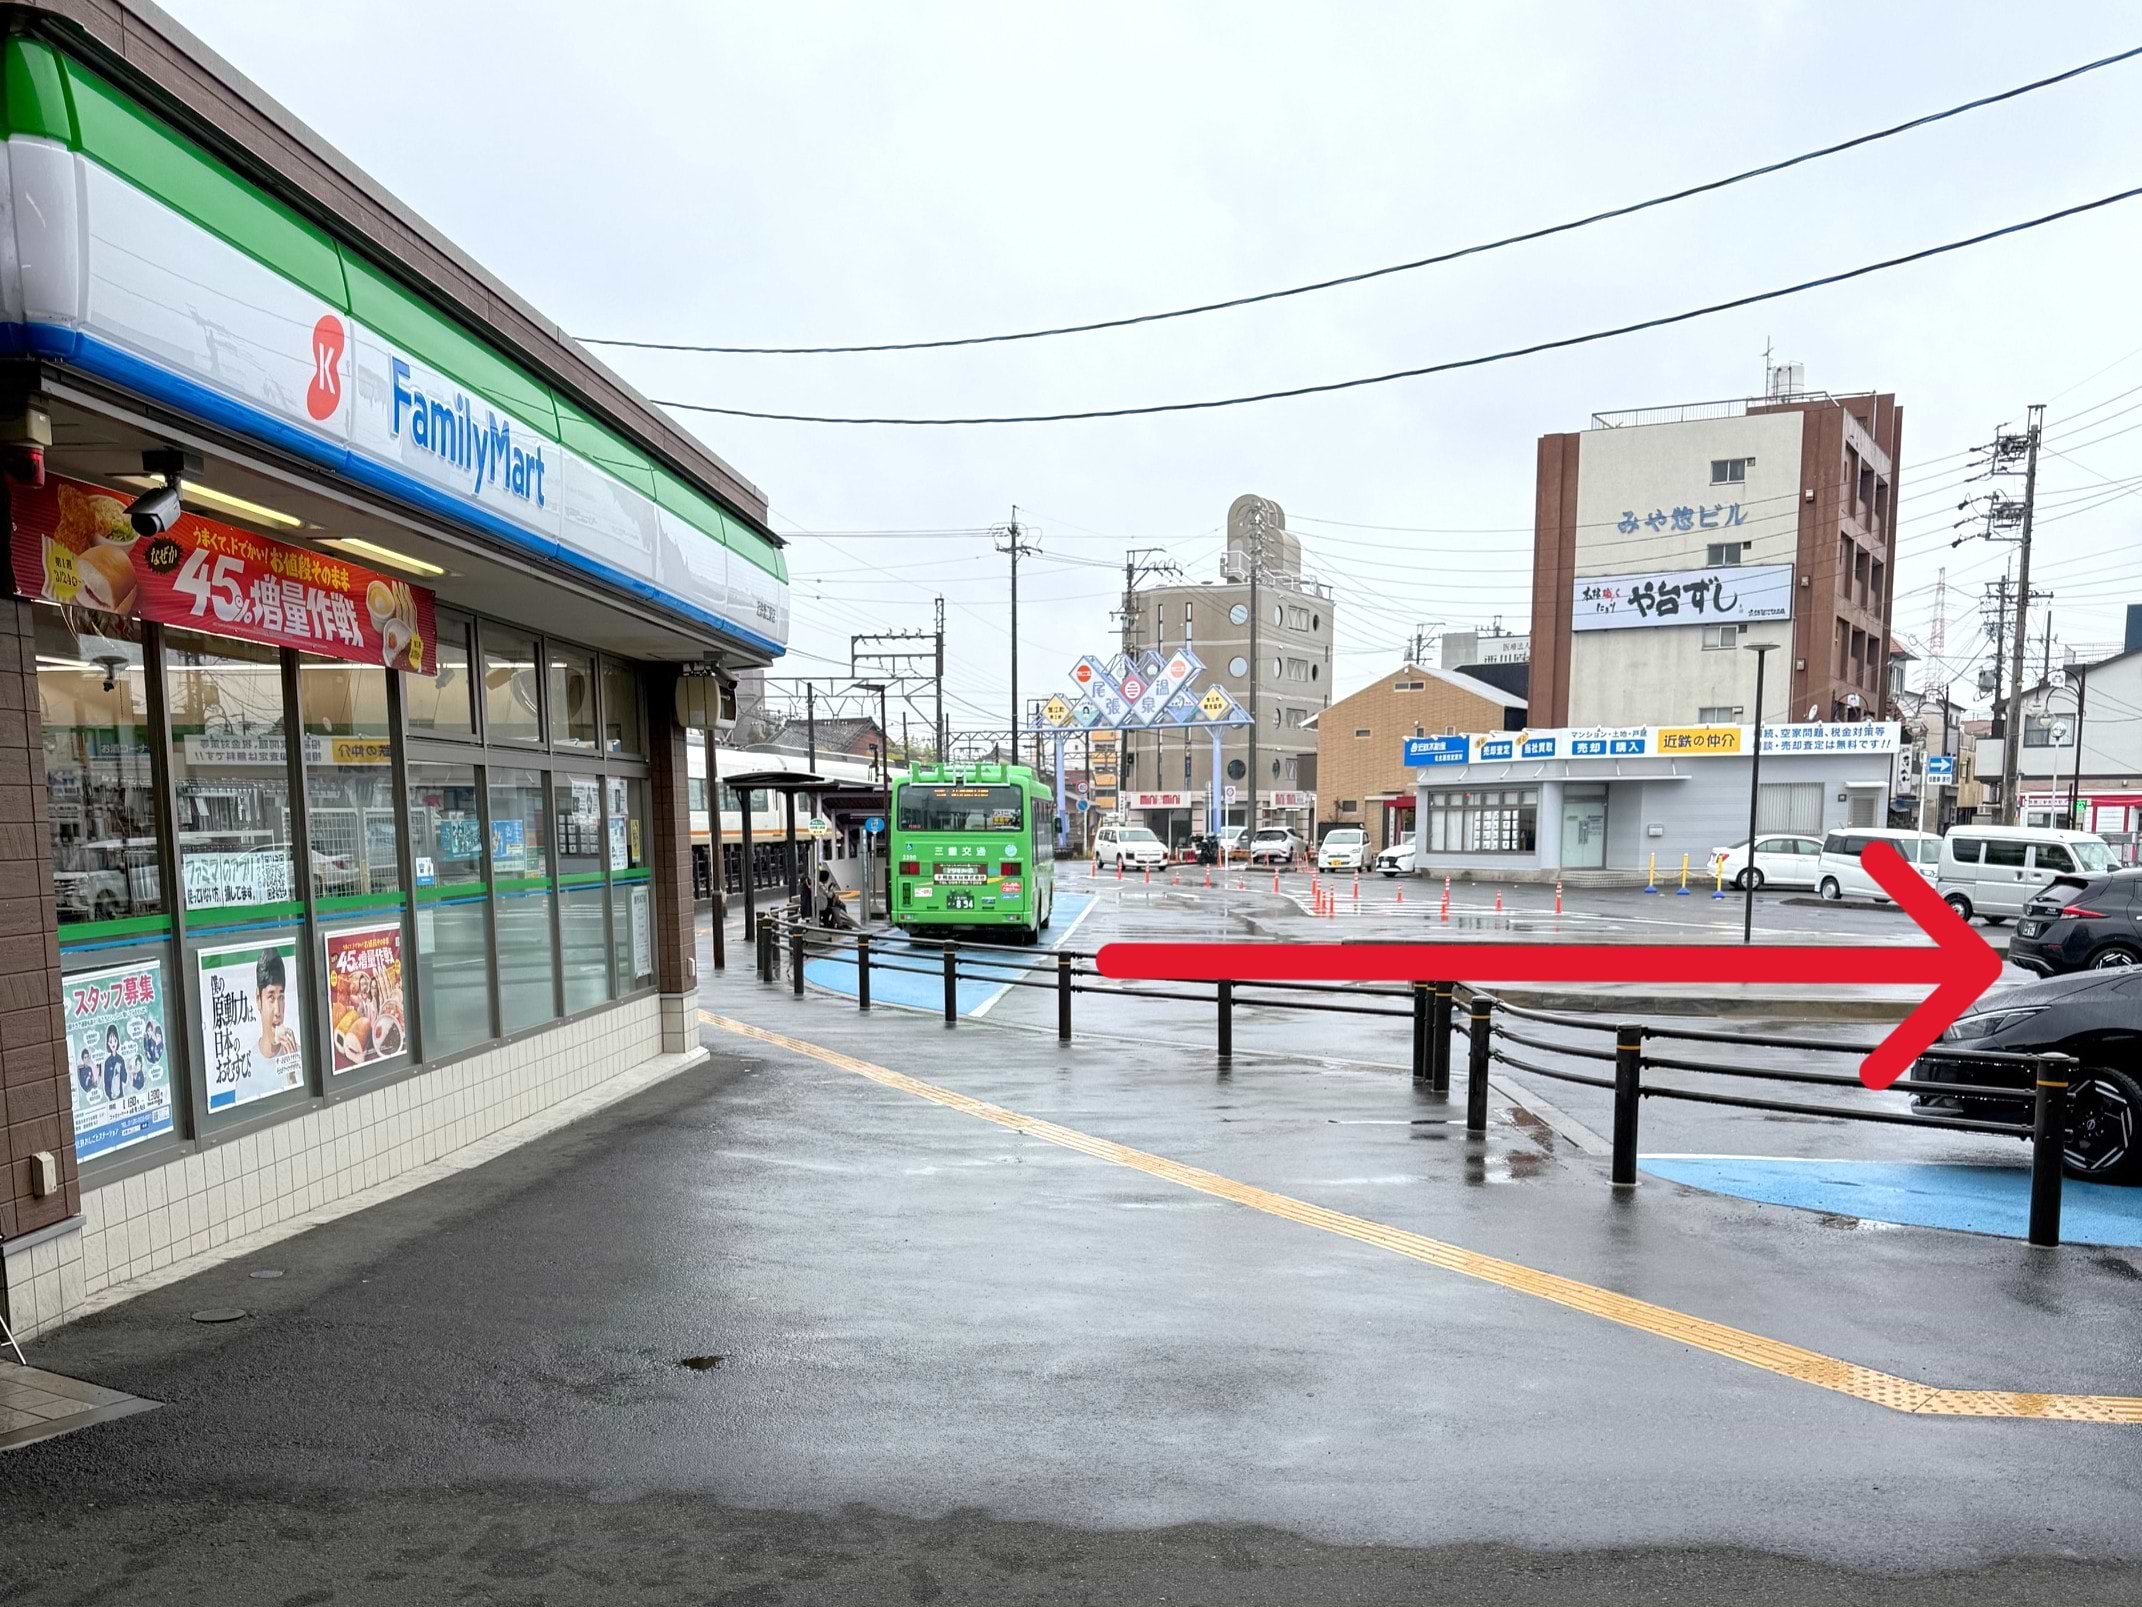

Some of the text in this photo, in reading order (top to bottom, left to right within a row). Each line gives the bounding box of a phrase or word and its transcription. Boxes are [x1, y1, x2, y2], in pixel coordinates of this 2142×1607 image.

[318, 342, 336, 395] K
[390, 353, 545, 508] FamilyMart
[150, 546, 178, 565] なぜか
[270, 550, 351, 592] お値段そのまま
[1627, 576, 1738, 617] や台ずし
[1576, 742, 1600, 754] 売却
[1616, 742, 1640, 753] 購入
[1663, 733, 1736, 749] 近鉄の仲介
[74, 974, 155, 1016] スタッフ募集
[214, 1027, 241, 1059] 日本の
